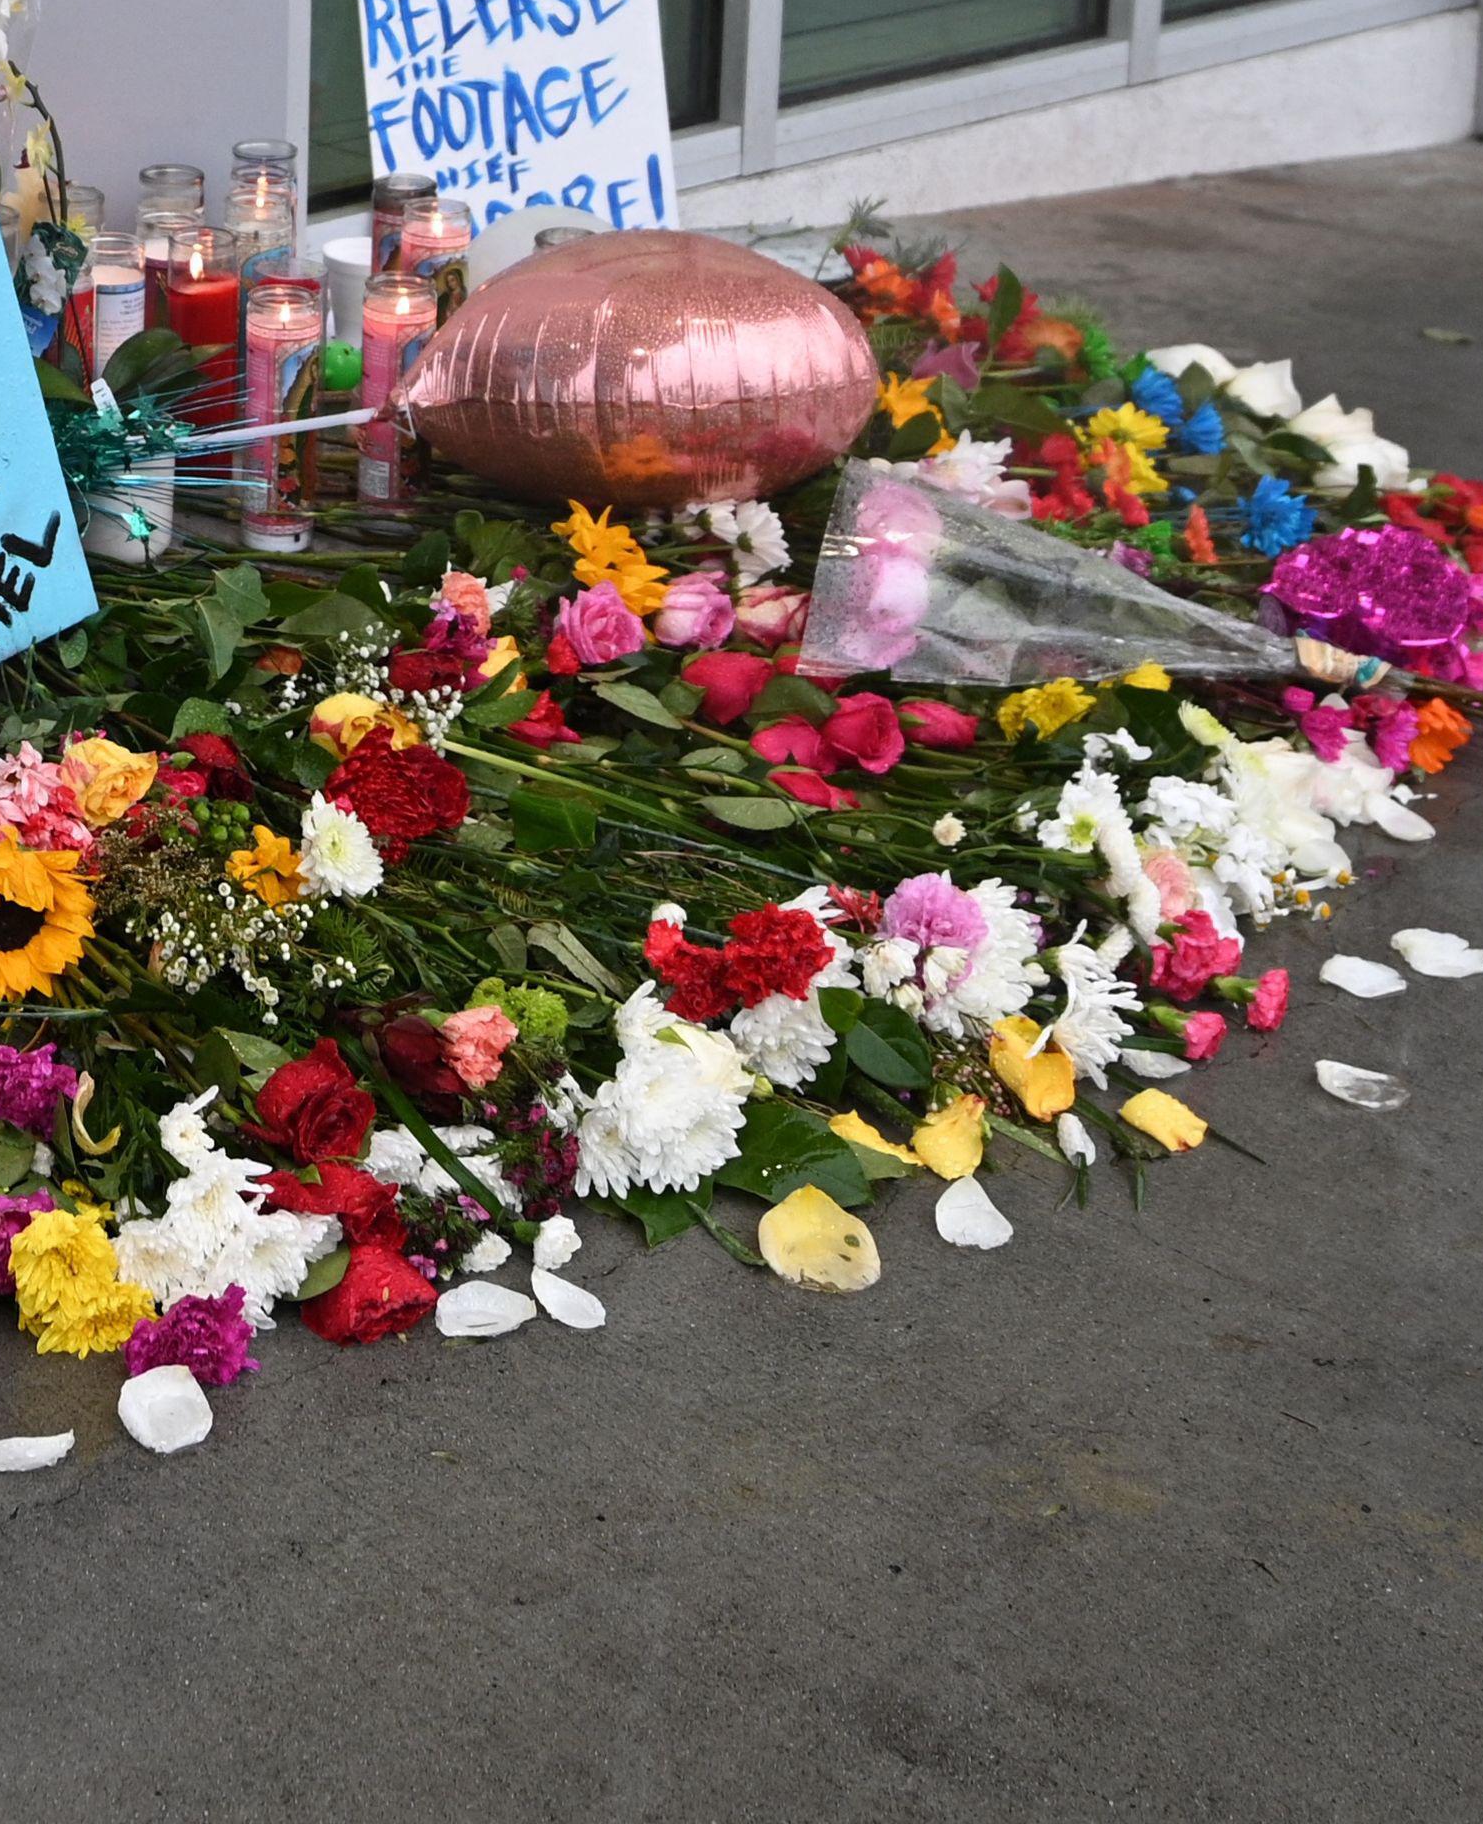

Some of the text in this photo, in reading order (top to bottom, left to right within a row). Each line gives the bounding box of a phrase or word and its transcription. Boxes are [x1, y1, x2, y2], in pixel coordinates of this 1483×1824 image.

[387, 55, 461, 88] THE
[369, 56, 630, 173] FOOTAGE
[435, 152, 531, 194] HIEF
